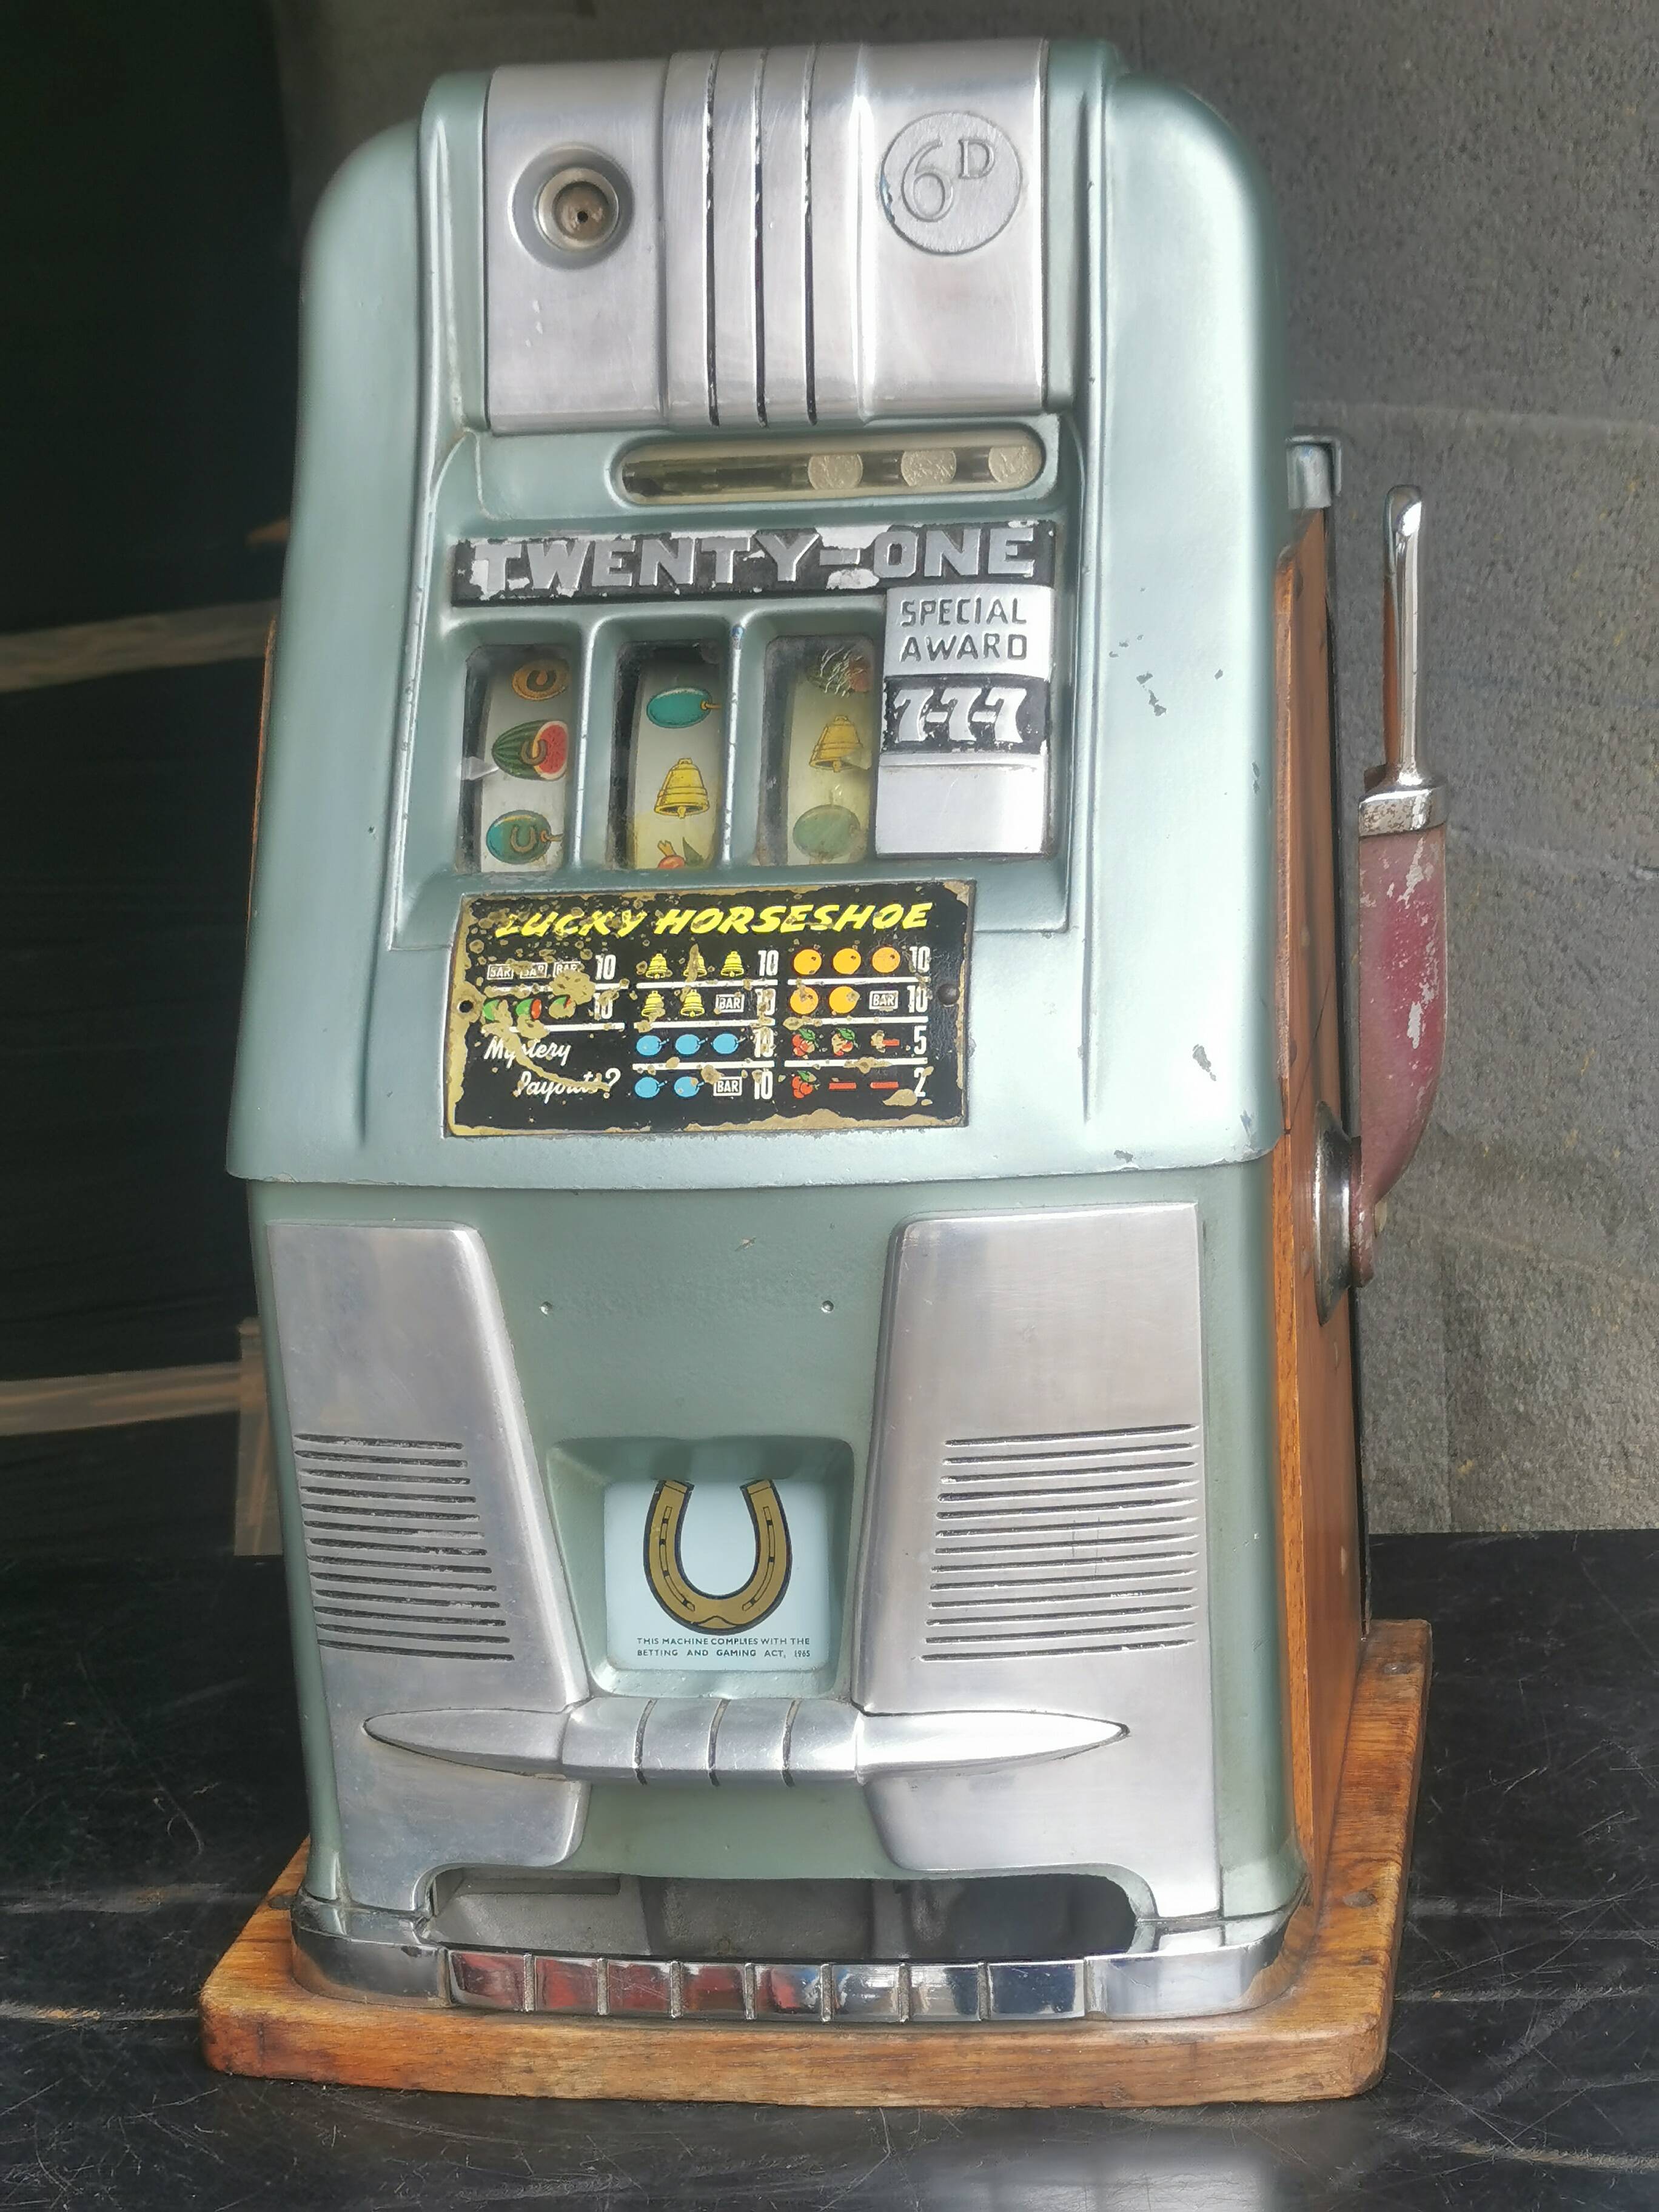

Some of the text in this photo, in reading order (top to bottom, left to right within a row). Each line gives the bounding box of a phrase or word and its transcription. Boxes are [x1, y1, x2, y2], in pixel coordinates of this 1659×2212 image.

[474, 528, 1034, 591] TWENTY-ONE
[900, 596, 1027, 626] SPECIAL
[900, 632, 1028, 662] AWARD
[893, 687, 1027, 743] 7-7-7
[495, 902, 933, 937] LUCKY HORSESHOE
[595, 954, 617, 980] 10
[758, 950, 779, 976] 10
[909, 946, 930, 973] 10
[594, 992, 613, 1020] 10
[718, 988, 776, 1016] BAR 10
[871, 985, 928, 1013] BAR 10
[752, 1027, 774, 1058] 10
[913, 1025, 927, 1054] 5
[513, 1067, 621, 1104] Payout?
[716, 1070, 774, 1100] BAR 10
[914, 1067, 928, 1097] 2
